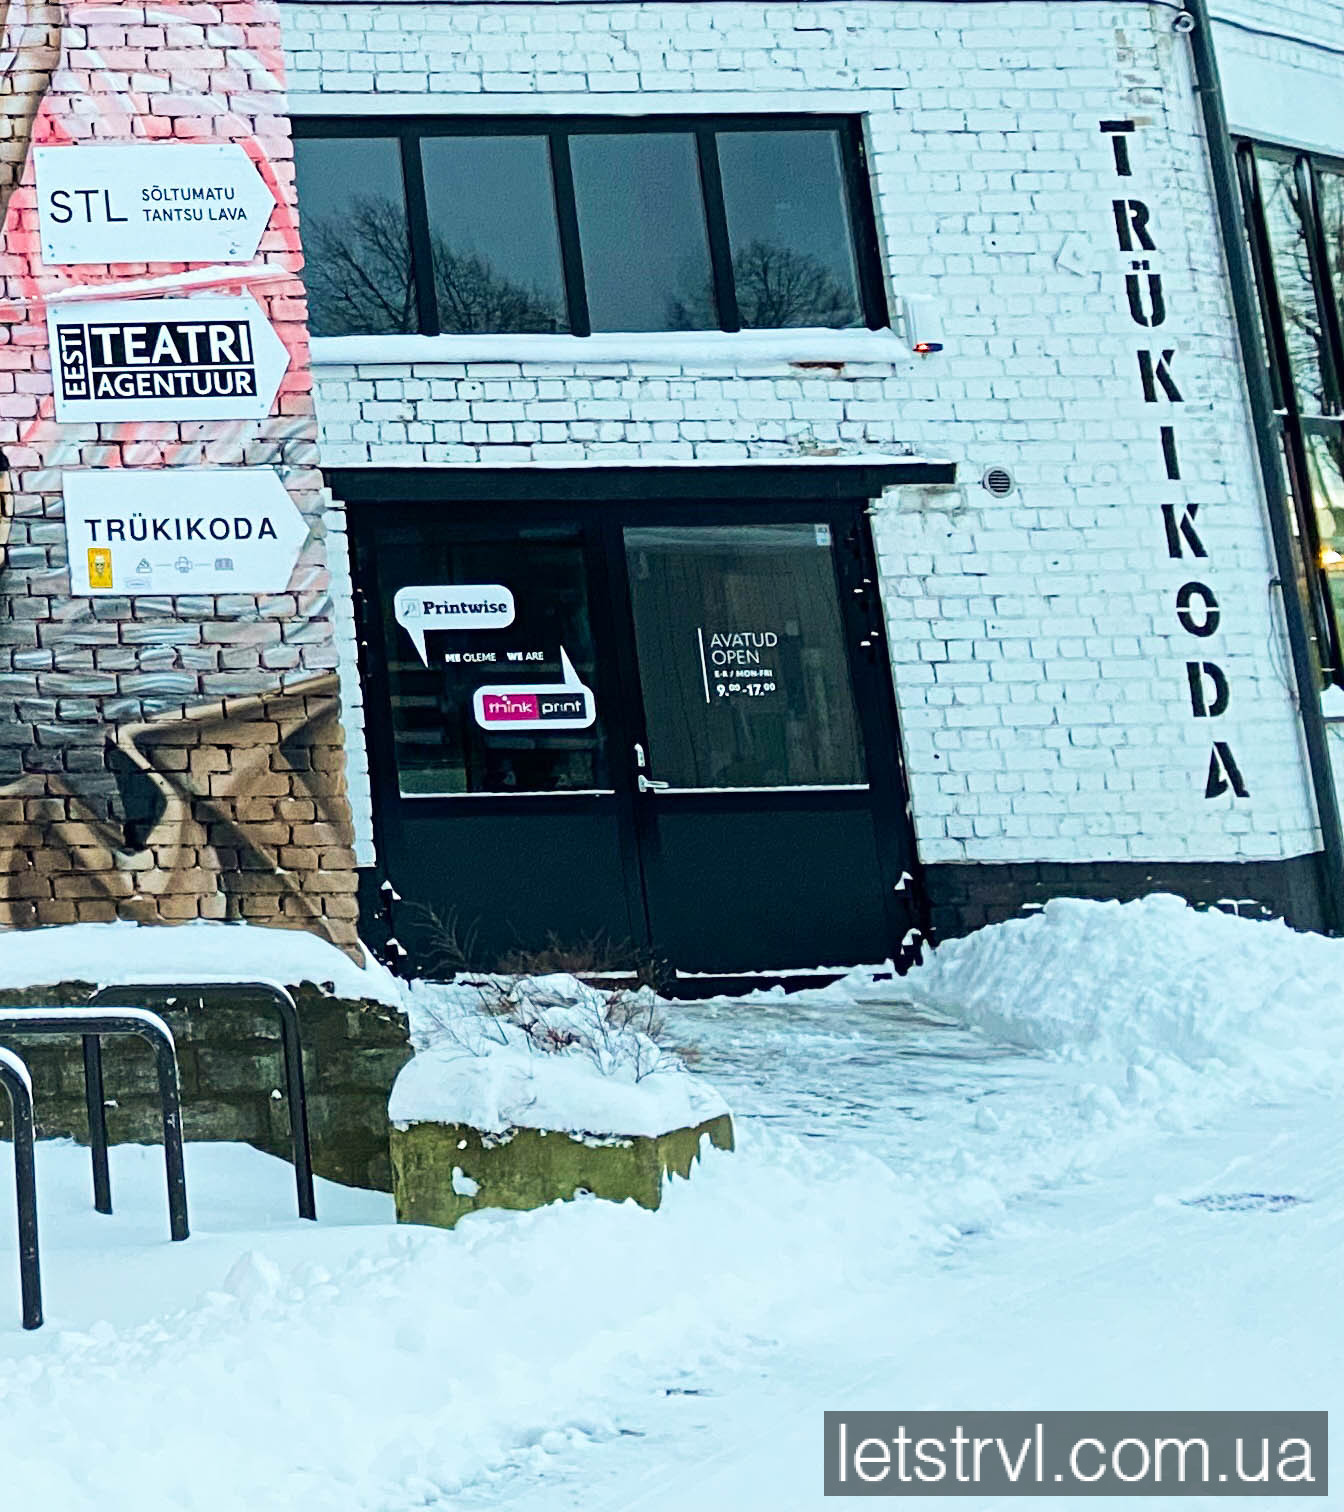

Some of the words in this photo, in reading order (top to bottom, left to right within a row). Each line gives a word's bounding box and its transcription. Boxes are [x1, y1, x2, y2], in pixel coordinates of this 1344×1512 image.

[141, 185, 236, 203] SÕLTUMATU
[49, 188, 129, 224] STL
[142, 207, 204, 223] TANTSU
[209, 207, 248, 222] LAVA
[90, 324, 252, 366] TEATRI
[59, 327, 88, 397] EESTI
[96, 369, 254, 399] AGENTUUR
[1099, 119, 1251, 800] TRÜKIKODA
[84, 512, 279, 542] TRÜKIKODA
[422, 599, 508, 615] Printwise
[710, 632, 778, 648] AVATUD
[463, 652, 497, 663] OLEME
[525, 651, 544, 661] ARE
[711, 649, 760, 665] OPEN
[735, 669, 773, 678] MON-FRI
[541, 700, 582, 715] print
